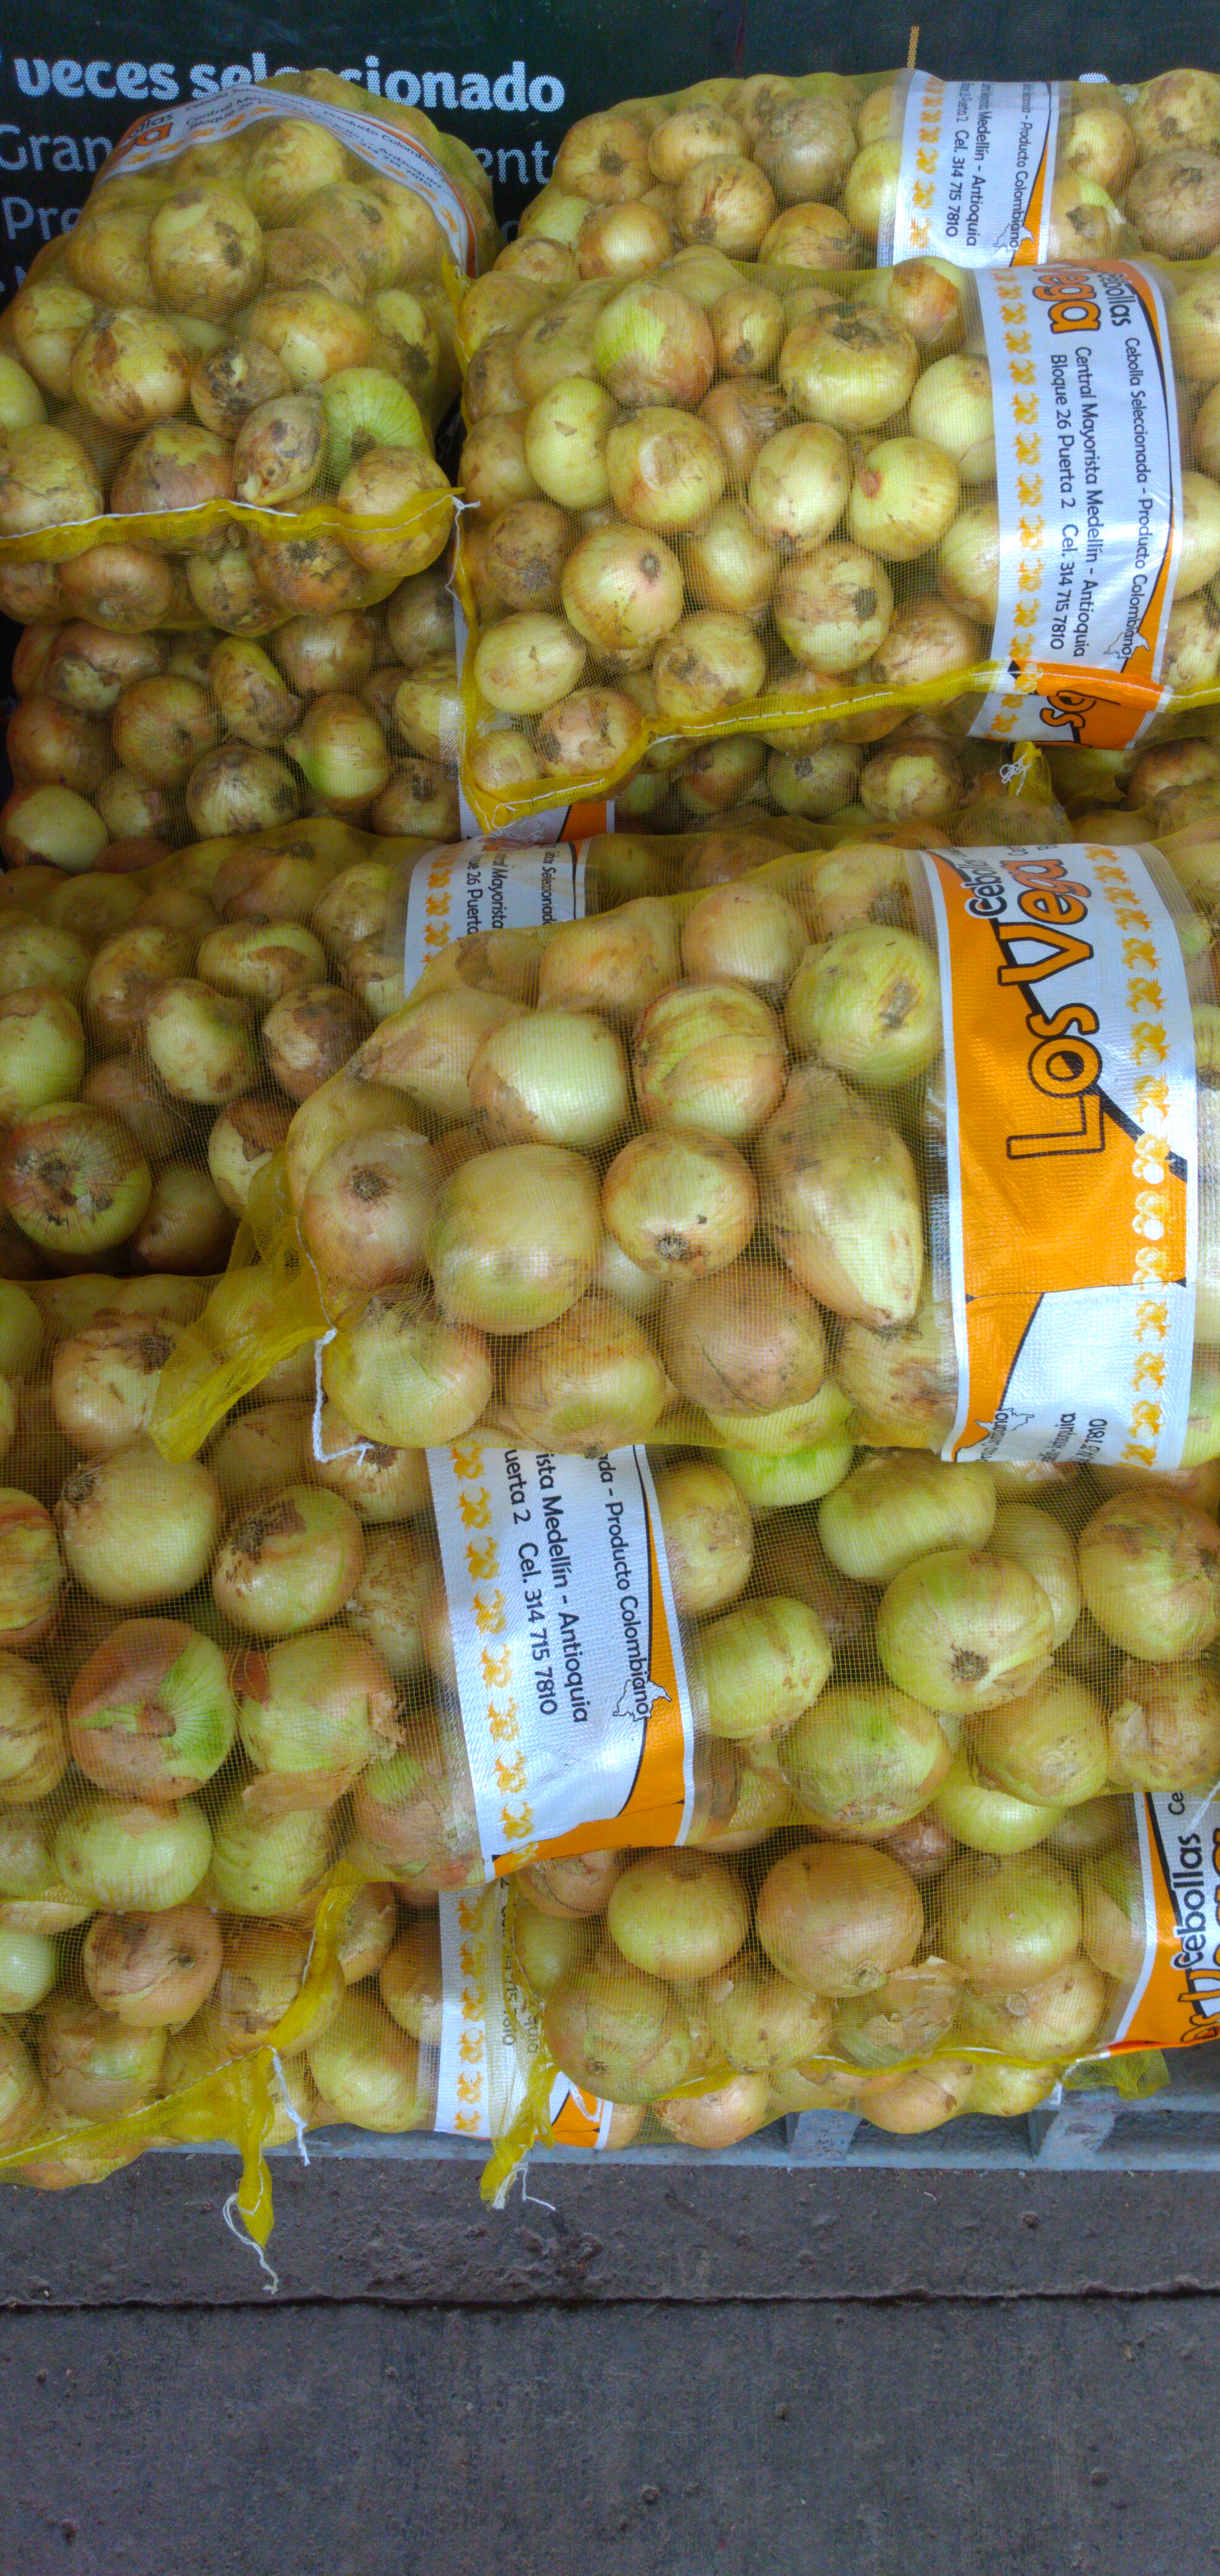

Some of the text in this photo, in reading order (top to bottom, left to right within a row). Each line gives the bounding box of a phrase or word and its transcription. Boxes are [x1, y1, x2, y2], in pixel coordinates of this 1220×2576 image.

[14, 58, 180, 100] veces
[190, 51, 565, 113] selionado
[951, 156, 965, 178] 314
[954, 129, 970, 153] Cel.
[974, 110, 993, 161] Medellín
[1016, 121, 1033, 168] Producto
[946, 205, 961, 237] 7810
[949, 181, 963, 201] 715
[965, 175, 987, 246] Antioquia
[1009, 170, 1029, 248] Colombiano
[1074, 346, 1097, 399] Central
[1125, 337, 1144, 386] Cebolla
[1079, 402, 1100, 484] Mayorista
[1130, 389, 1151, 483] Seleccionada
[1050, 354, 1079, 650] Bloque 26 Puerta 2 Cel. 314 715 7810
[1086, 489, 1105, 563] Medellín
[1135, 498, 1154, 569] Producto
[1073, 579, 1099, 658] Antioquia
[1122, 573, 1148, 656] Colombiano
[466, 871, 481, 886] 26
[467, 888, 484, 935] Puerta
[487, 868, 508, 929] Mayorista
[957, 858, 1008, 917] Cebolla
[998, 858, 1105, 1160] Los Vega
[504, 1449, 558, 1715] uerta 2 Cel. 314 715 7810
[542, 1495, 572, 1588] Medellín
[558, 1611, 591, 1723] Antioquia
[605, 1501, 632, 1591] Producto
[620, 1595, 649, 1715] Colombiano
[1173, 1832, 1206, 1969] Cebollas
